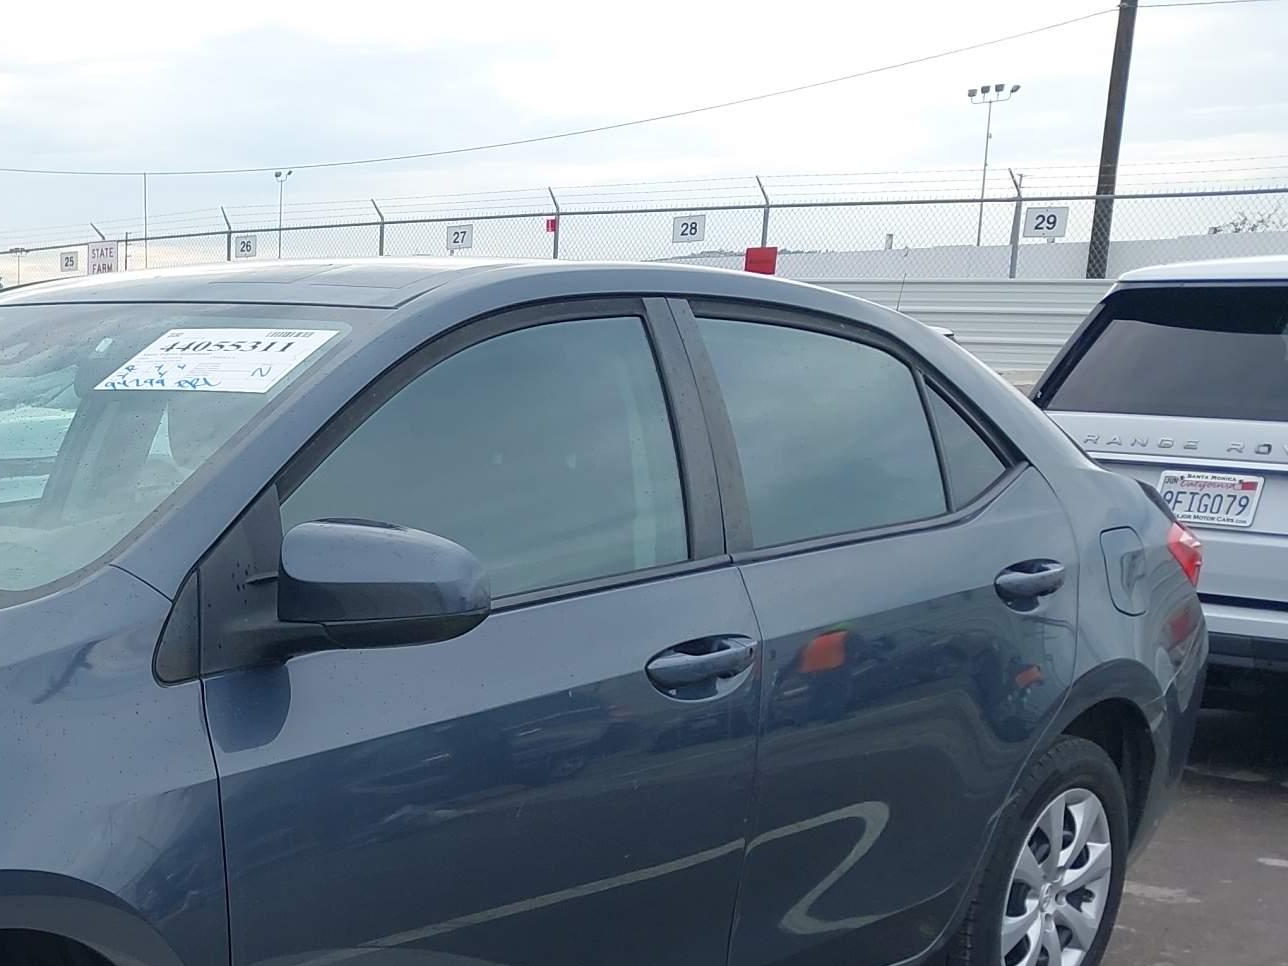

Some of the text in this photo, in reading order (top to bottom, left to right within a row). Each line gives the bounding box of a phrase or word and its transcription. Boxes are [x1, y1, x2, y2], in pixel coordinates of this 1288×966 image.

[679, 222, 698, 236] 28
[1033, 214, 1057, 231] 29
[452, 230, 467, 244] 27
[91, 247, 114, 259] STATE
[240, 240, 252, 253] 26
[64, 256, 75, 268] 25
[92, 263, 113, 274] FARM
[160, 341, 296, 353] 44055311
[1083, 434, 1201, 450] RANGE
[1180, 480, 1236, 492] California
[1163, 490, 1250, 516] 9FIG079
